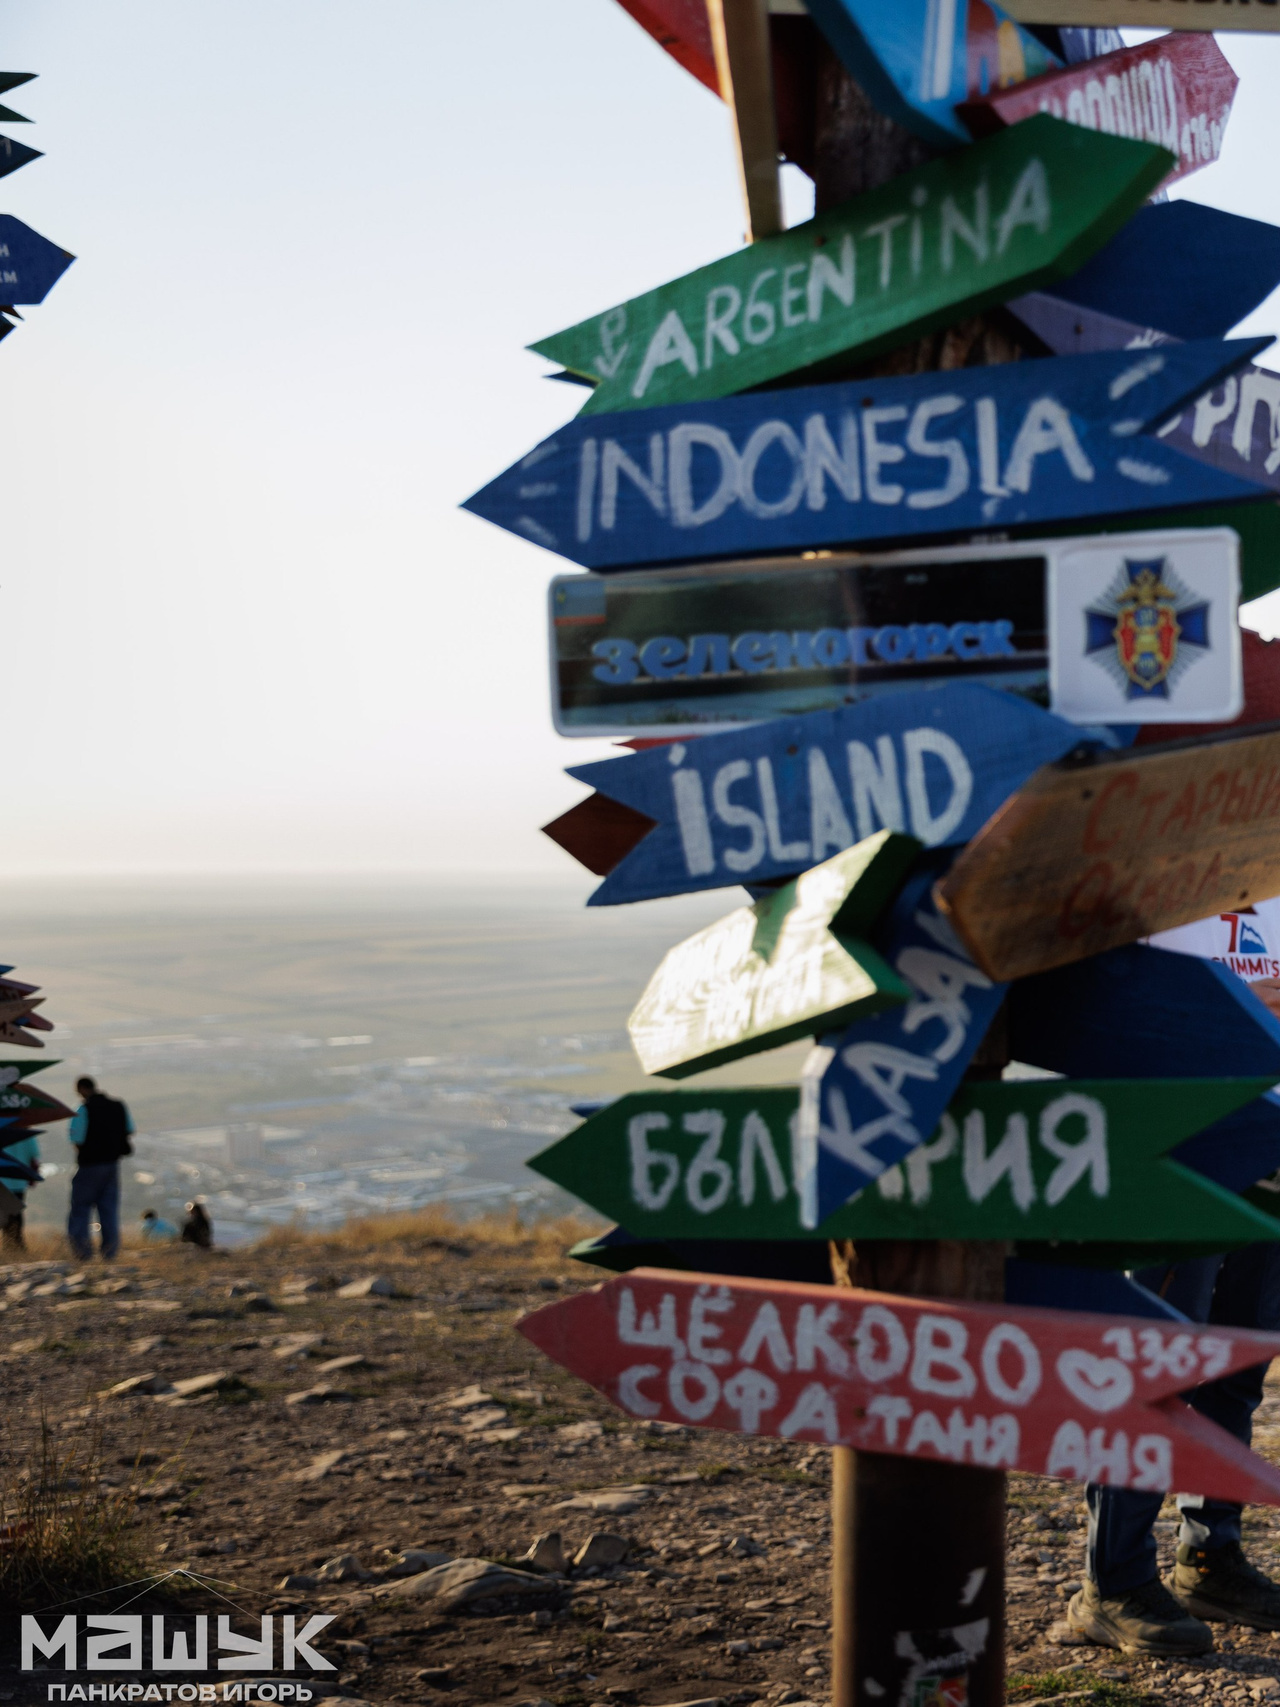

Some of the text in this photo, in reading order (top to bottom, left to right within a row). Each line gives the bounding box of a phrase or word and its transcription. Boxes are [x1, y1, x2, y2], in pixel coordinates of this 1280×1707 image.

[577, 394, 1094, 543] INDONESIA
[627, 1091, 1111, 1216] БЪЛРИЯ
[618, 1285, 1041, 1405] ЩЁЛКОВО
[864, 1394, 1020, 1469] ТАНЯ
[1047, 1419, 1173, 1493] АНЯ
